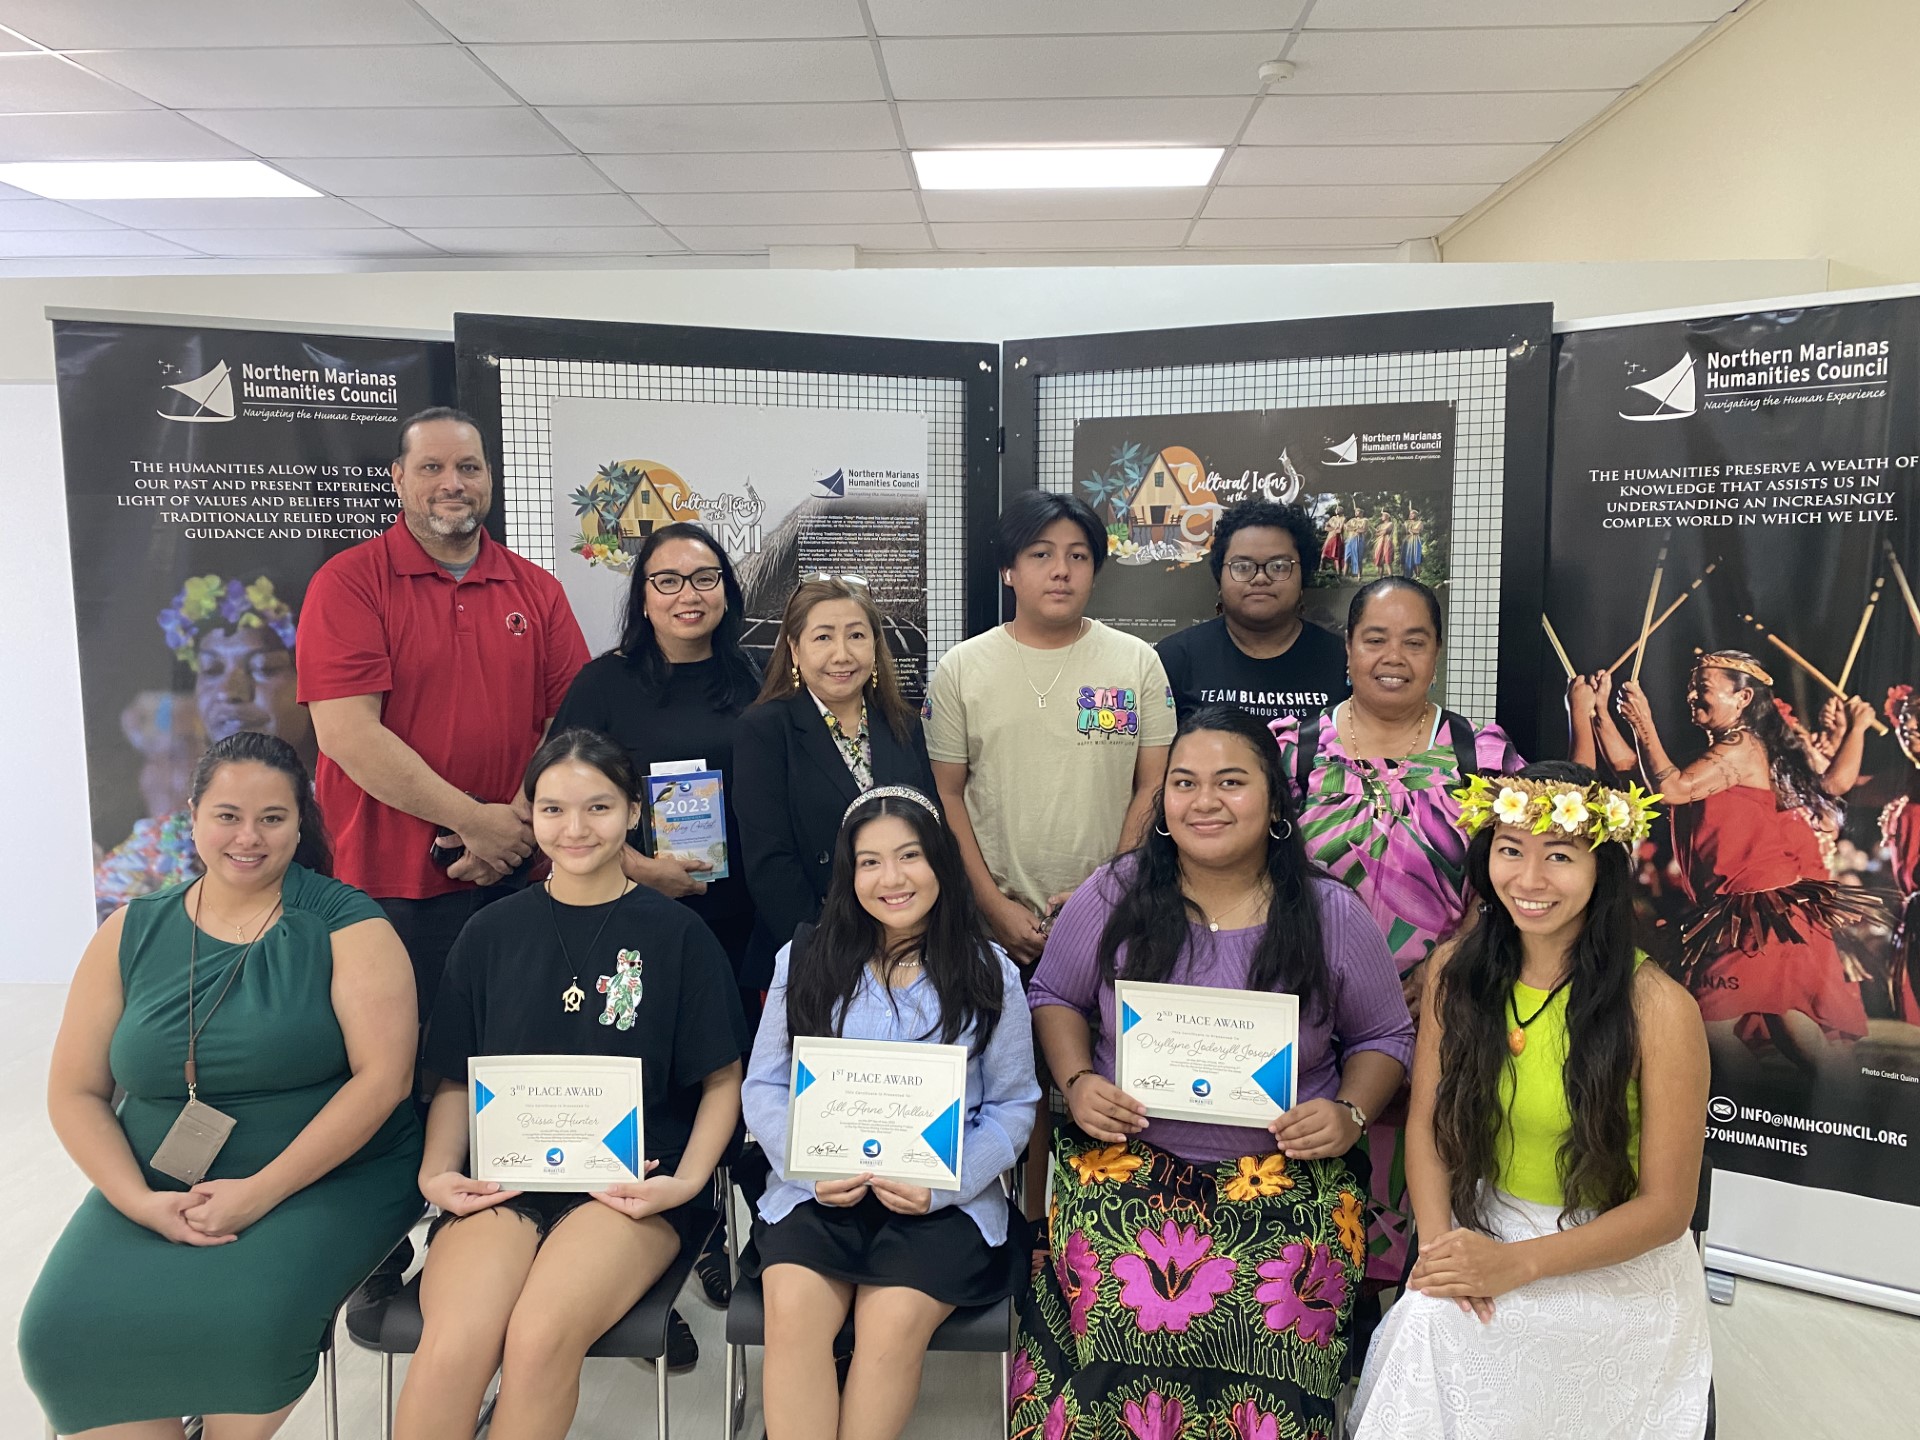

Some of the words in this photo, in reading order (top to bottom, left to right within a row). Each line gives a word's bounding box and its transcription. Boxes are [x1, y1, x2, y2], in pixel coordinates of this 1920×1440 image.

[1707, 348, 1793, 369] Northern
[1800, 340, 1889, 362] Marianas
[242, 363, 319, 383] Northern
[324, 367, 397, 387] Marianas
[1707, 365, 1810, 389] Humanities
[1817, 357, 1888, 381] Council
[243, 382, 335, 401] Humanities
[341, 386, 397, 404] Council
[1704, 398, 1760, 413] Navigating
[1762, 395, 1781, 406] the
[1782, 392, 1825, 404] Human
[1826, 388, 1887, 404] Experience
[242, 408, 294, 422] Navigating
[296, 410, 312, 419] the
[314, 411, 348, 421] Human
[350, 413, 398, 425] Experience
[1362, 432, 1401, 442] Northern
[1402, 431, 1442, 441] Marianas
[1361, 441, 1408, 452] Humanities
[1410, 440, 1442, 450] Council
[169, 462, 264, 475] HUMANITIES
[268, 464, 317, 475] ALLOW
[321, 466, 339, 476] US
[342, 466, 362, 477] TO
[367, 467, 393, 477] EXA
[848, 469, 884, 478] Northern
[885, 470, 920, 479] Marianas
[1624, 465, 1720, 481] HUMANITIES
[1725, 461, 1800, 476] PRESERVE
[1804, 461, 1816, 473] A
[1821, 457, 1889, 471] WEALTH
[1895, 456, 1919, 468] OF
[134, 479, 170, 490] OUR
[174, 479, 208, 490] PAST
[212, 480, 246, 490] AND
[251, 480, 312, 491] PRESENT
[848, 478, 890, 488] Humanities
[892, 479, 920, 488] Council
[1188, 470, 1250, 494] Cultural
[1252, 471, 1288, 493] Icons
[1620, 482, 1716, 497] KNOWLEDGE
[1720, 480, 1763, 493] THAT
[1766, 477, 1828, 491] ASSISTS
[1833, 476, 1855, 489] US
[1861, 475, 1880, 487] IN
[117, 495, 166, 506] LIGHT
[170, 495, 190, 506] OF
[194, 496, 247, 507] VALUES
[251, 496, 284, 507] AND
[289, 497, 340, 508] BELIEFS
[343, 498, 380, 508] THAT
[383, 498, 403, 508] WE
[672, 491, 726, 511] Cultural
[727, 494, 759, 513] Icons
[1235, 491, 1248, 501] the
[1606, 497, 1739, 513] UNDERSTANDING
[1743, 496, 1767, 509] AN
[1773, 492, 1896, 508] INCREASINGLY
[160, 512, 279, 523] TRADITIONALLY
[283, 512, 332, 523] RELIED
[336, 513, 375, 524] UPON
[380, 513, 398, 524] FO
[1602, 516, 1672, 529] COMPLEX
[1676, 514, 1733, 527] WORLD
[1738, 514, 1757, 526] IN
[1761, 512, 1822, 525] WHICH
[1828, 510, 1852, 523] WE
[1858, 509, 1898, 523] LIVE.
[184, 528, 264, 539] GUIDANCE
[268, 528, 301, 539] AND
[306, 528, 383, 539] DIRECTION
[1200, 689, 1236, 703] TEAM
[1239, 690, 1329, 706] BLACKSHEEP
[1239, 706, 1278, 717] RIOUS
[1282, 708, 1307, 717] TOYS
[665, 797, 710, 815] 2023
[1176, 1013, 1211, 1026] PLACE
[1213, 1017, 1255, 1030] AWARD
[846, 1072, 882, 1084] PLACE
[883, 1075, 923, 1087] AWARD
[1861, 1066, 1880, 1077] Photo
[1880, 1070, 1899, 1081] Credit
[1900, 1073, 1919, 1084] Quinn
[528, 1086, 562, 1096] PLACE
[564, 1086, 603, 1097] AWARD
[847, 1099, 884, 1116] Anne
[555, 1112, 600, 1128] Hunter
[1740, 1105, 1908, 1148] INFO@NMHCOUNCIL.ORG
